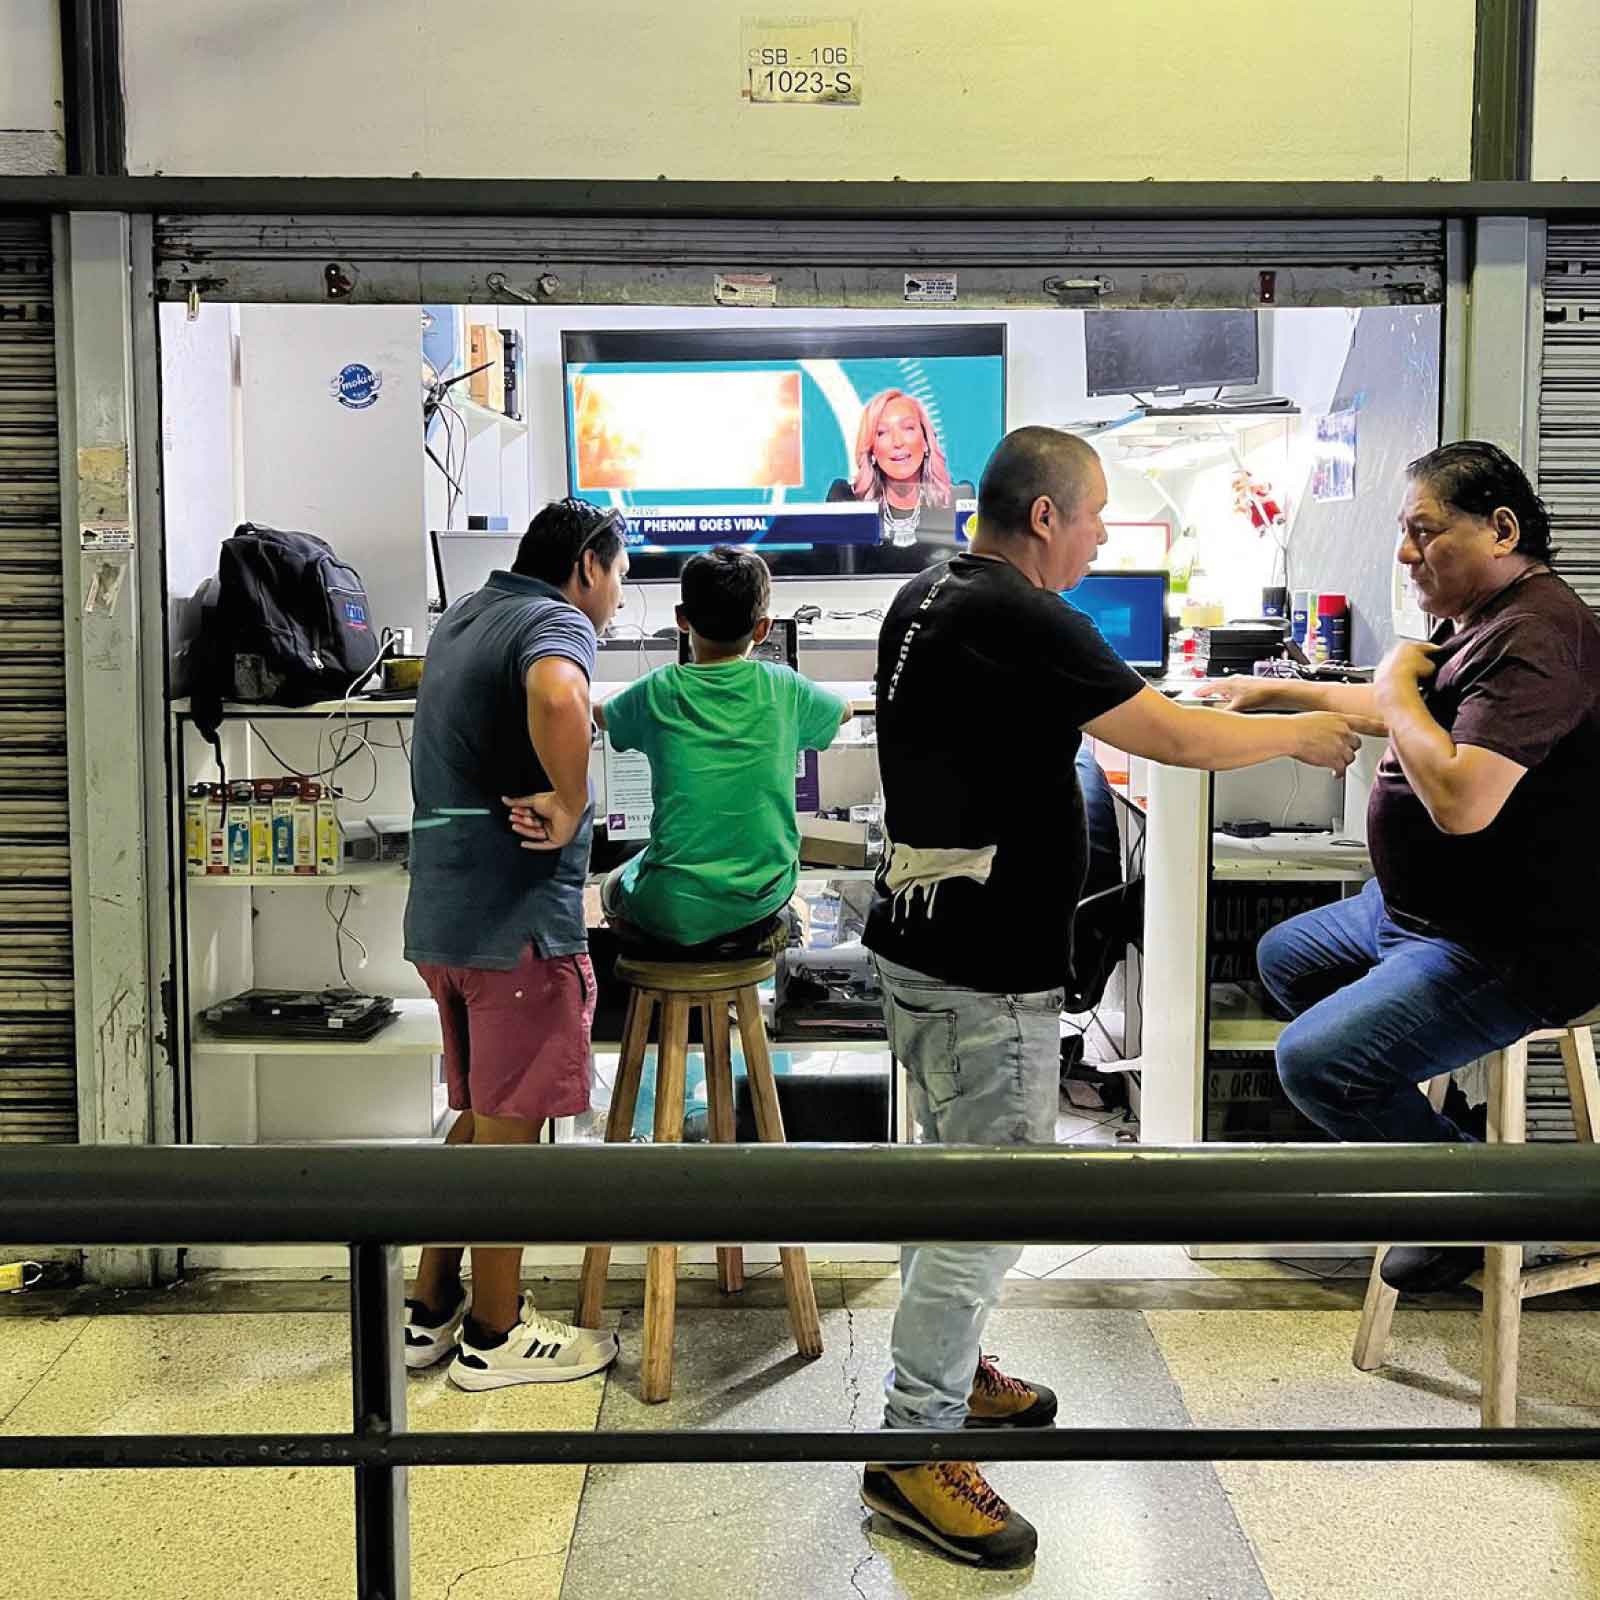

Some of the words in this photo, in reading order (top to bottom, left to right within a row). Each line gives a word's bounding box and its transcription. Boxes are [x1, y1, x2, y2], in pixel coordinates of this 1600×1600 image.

[810, 47, 848, 64] 106
[764, 71, 852, 94] 1023-S
[643, 519, 696, 533] PHENOM
[699, 517, 732, 532] GOES
[734, 517, 769, 532] VIRAL
